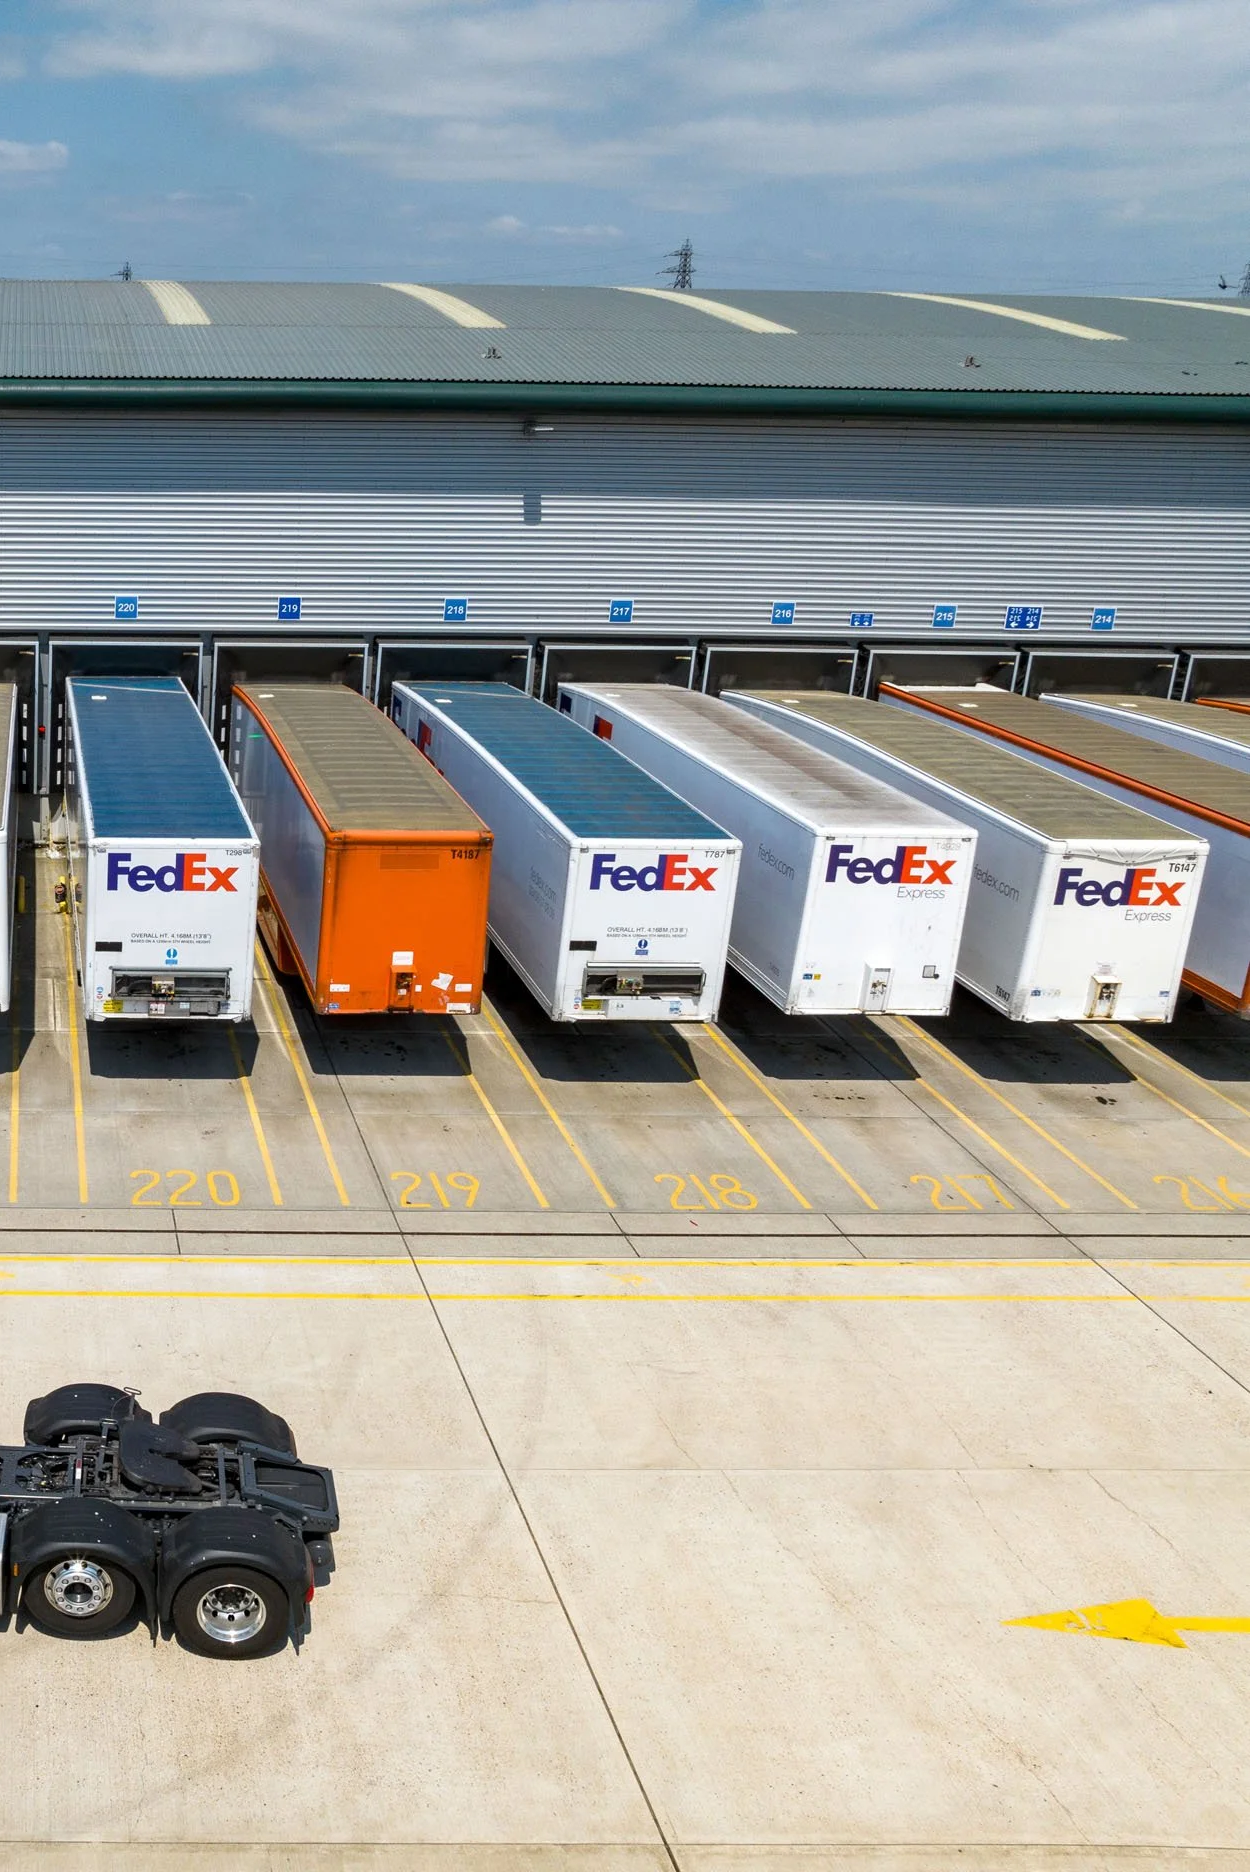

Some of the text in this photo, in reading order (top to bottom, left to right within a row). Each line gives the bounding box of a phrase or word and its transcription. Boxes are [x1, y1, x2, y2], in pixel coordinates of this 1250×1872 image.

[118, 603, 135, 612] 220
[282, 604, 298, 612] 219
[447, 606, 464, 614] 218
[613, 607, 630, 615] 217
[775, 609, 791, 618] 216
[936, 612, 953, 621] 215
[1095, 615, 1111, 623] 214
[451, 849, 480, 859] T4187
[704, 850, 725, 859] T787
[758, 843, 795, 881] fedex.com
[825, 844, 957, 885] FedEx
[1168, 863, 1197, 873] T6147
[107, 853, 239, 892] FedEx
[589, 853, 719, 892] FedEx
[973, 865, 1020, 902] fedex.com
[1053, 867, 1186, 906] FedEx
[897, 886, 945, 901] Express
[1124, 909, 1172, 922] Express
[129, 1169, 241, 1207] 220
[390, 1170, 481, 1208] 219
[653, 1173, 759, 1210] 218
[909, 1173, 1015, 1210] 217
